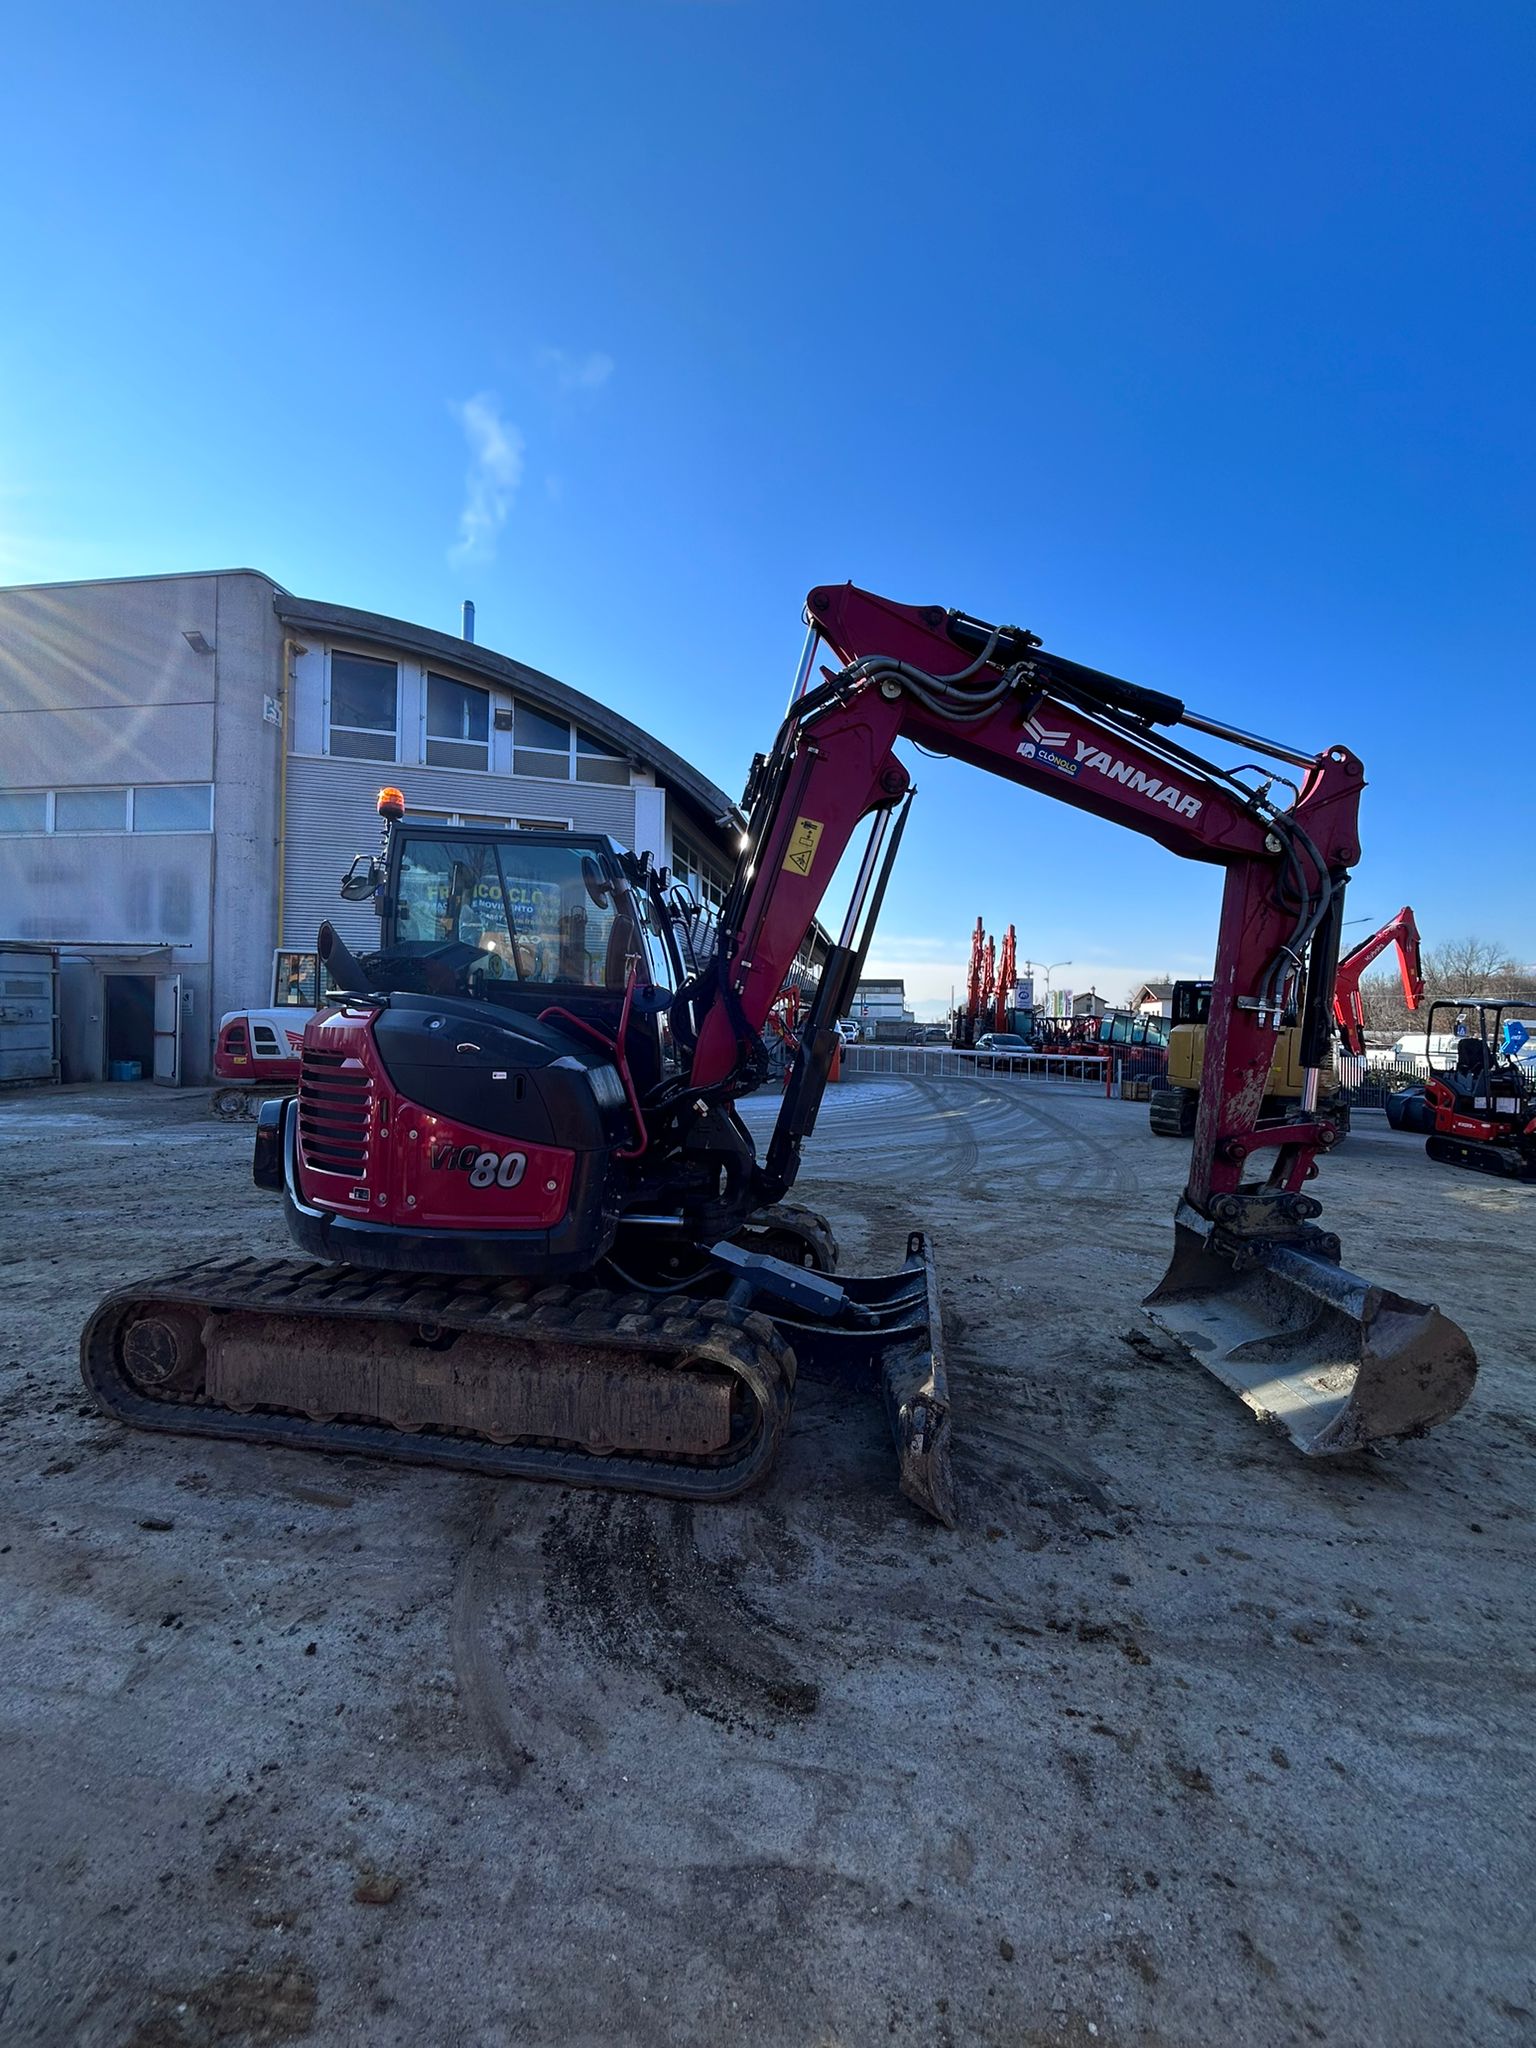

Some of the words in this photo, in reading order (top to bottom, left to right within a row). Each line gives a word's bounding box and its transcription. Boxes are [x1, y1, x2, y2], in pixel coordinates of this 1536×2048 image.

[1073, 739, 1203, 819] YANMAR
[427, 883, 502, 900] FRCO
[468, 1151, 528, 1189] 80
